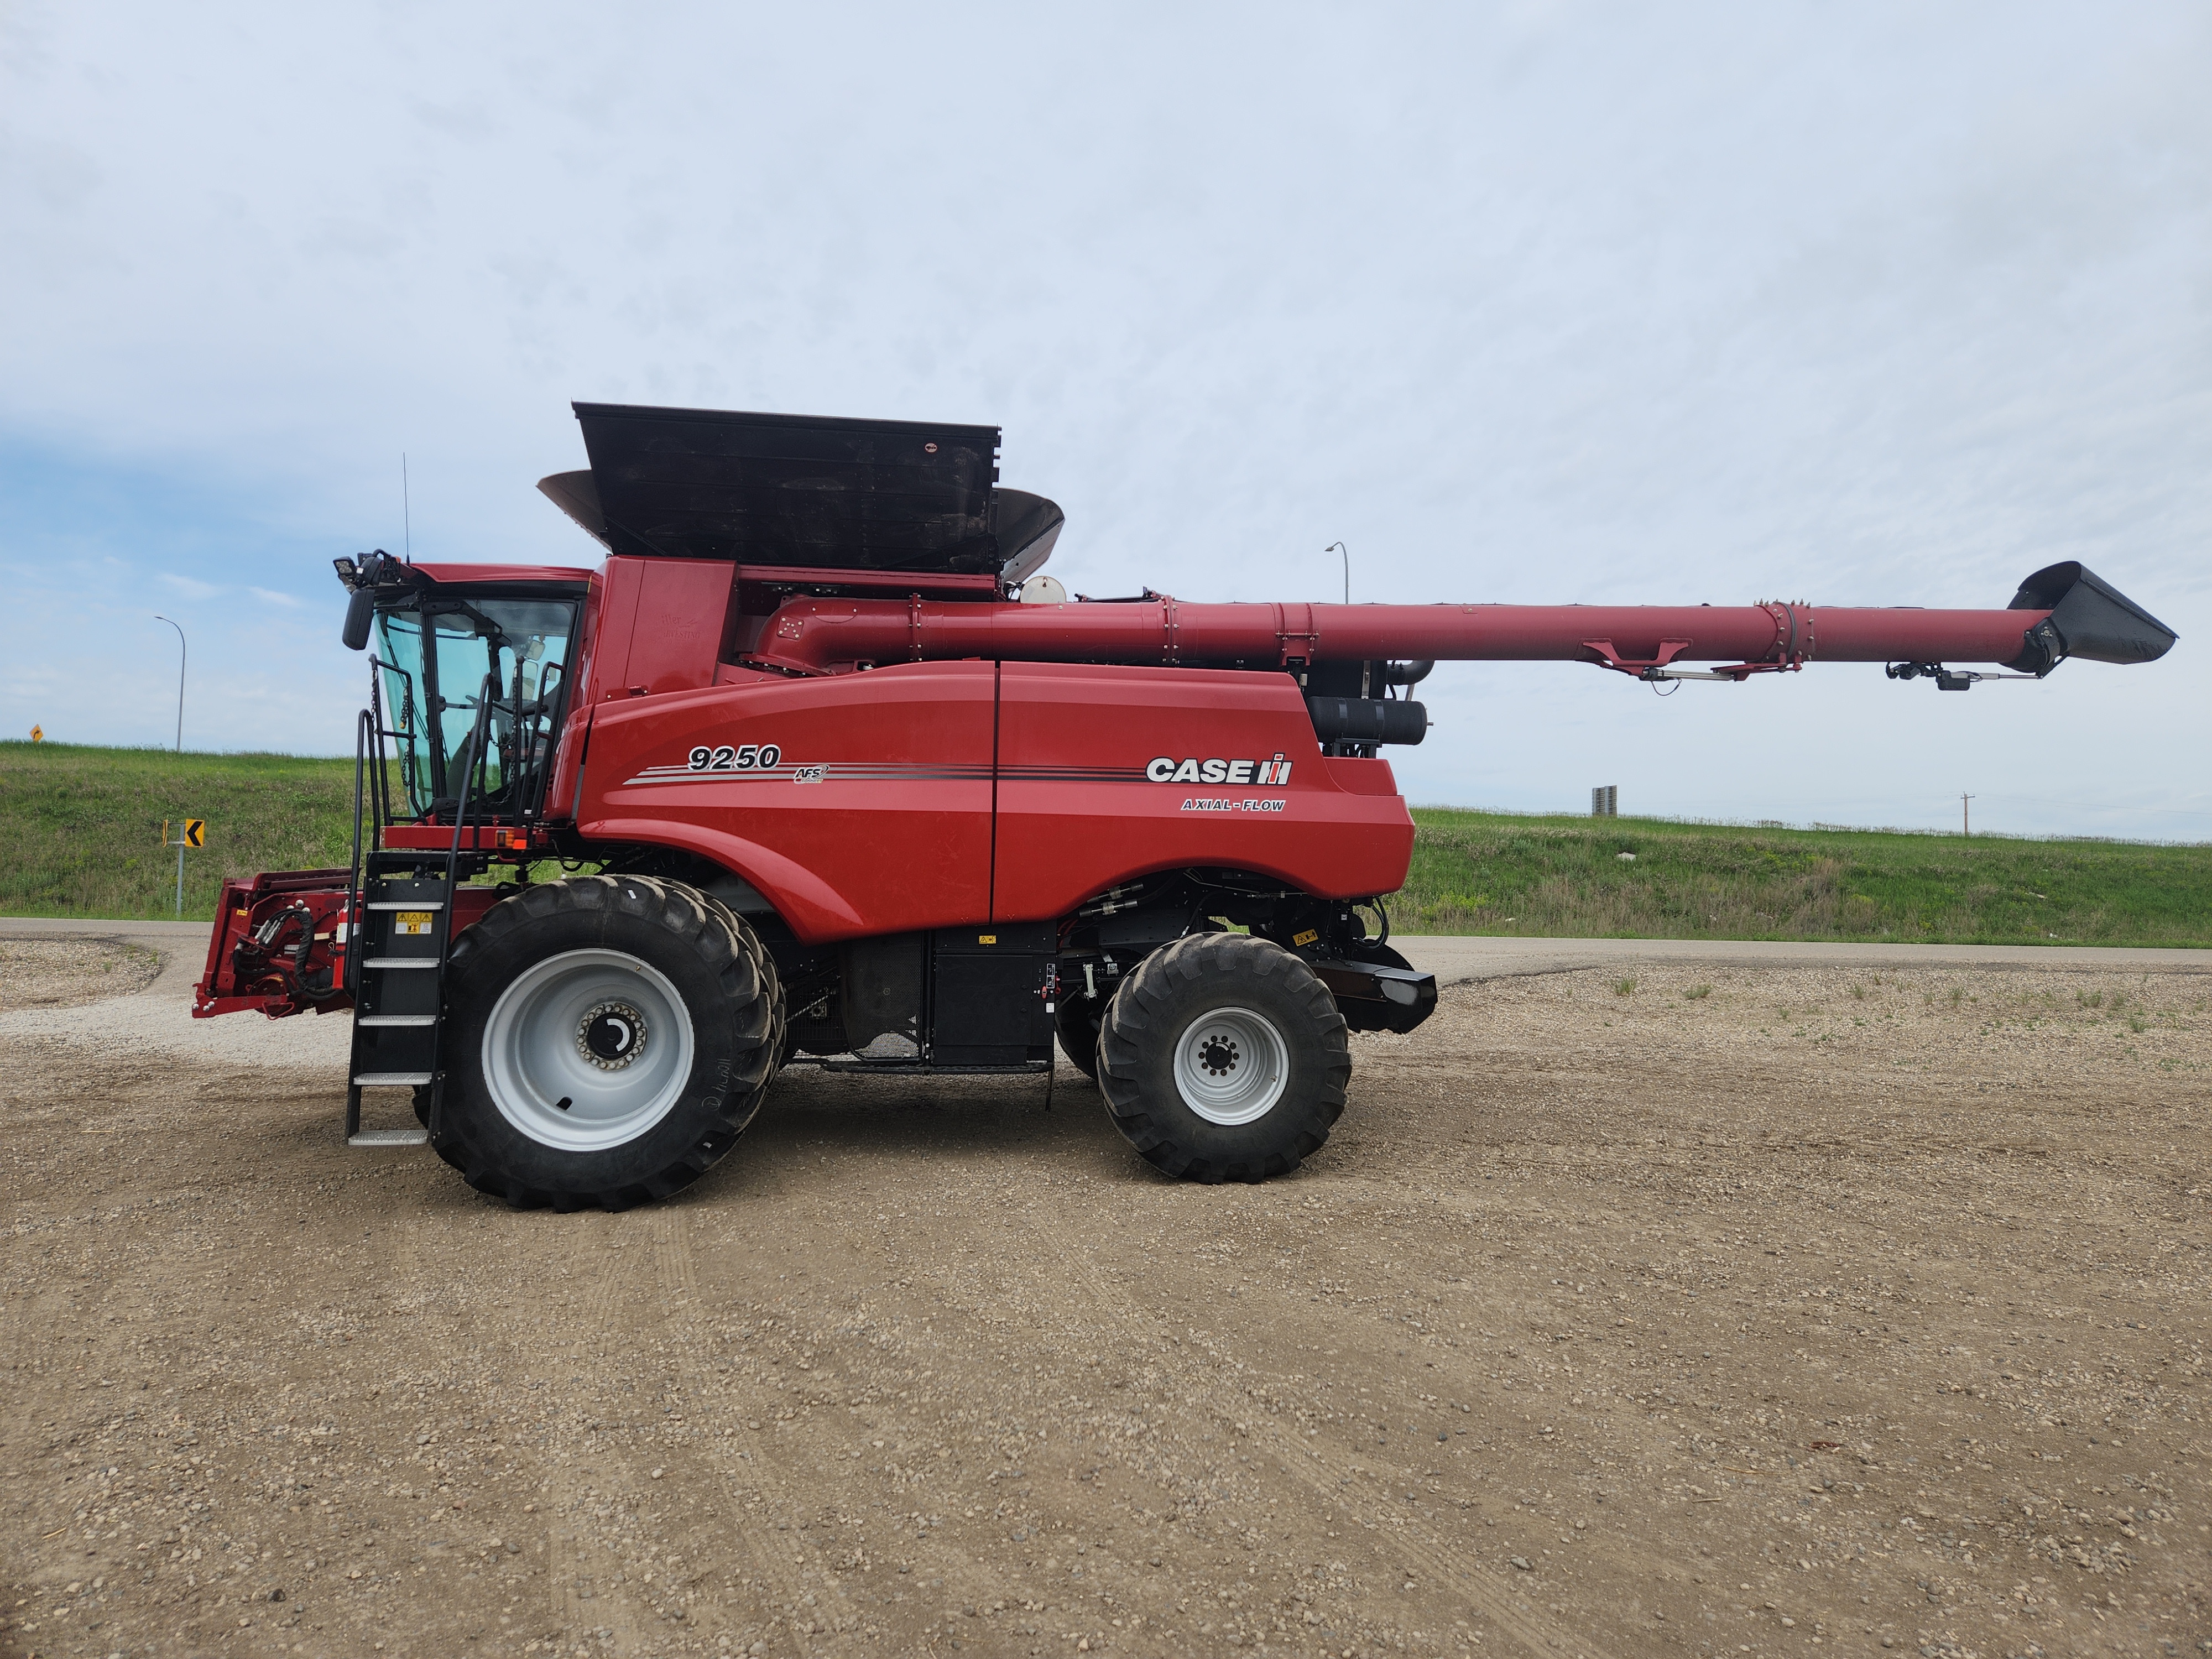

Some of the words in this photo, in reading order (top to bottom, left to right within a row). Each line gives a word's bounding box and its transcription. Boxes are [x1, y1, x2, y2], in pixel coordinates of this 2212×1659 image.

[687, 744, 781, 770] 9250
[794, 768, 822, 779] AFS
[1146, 758, 1254, 783] CASE
[1181, 799, 1286, 812] AXIAL-FLOW
